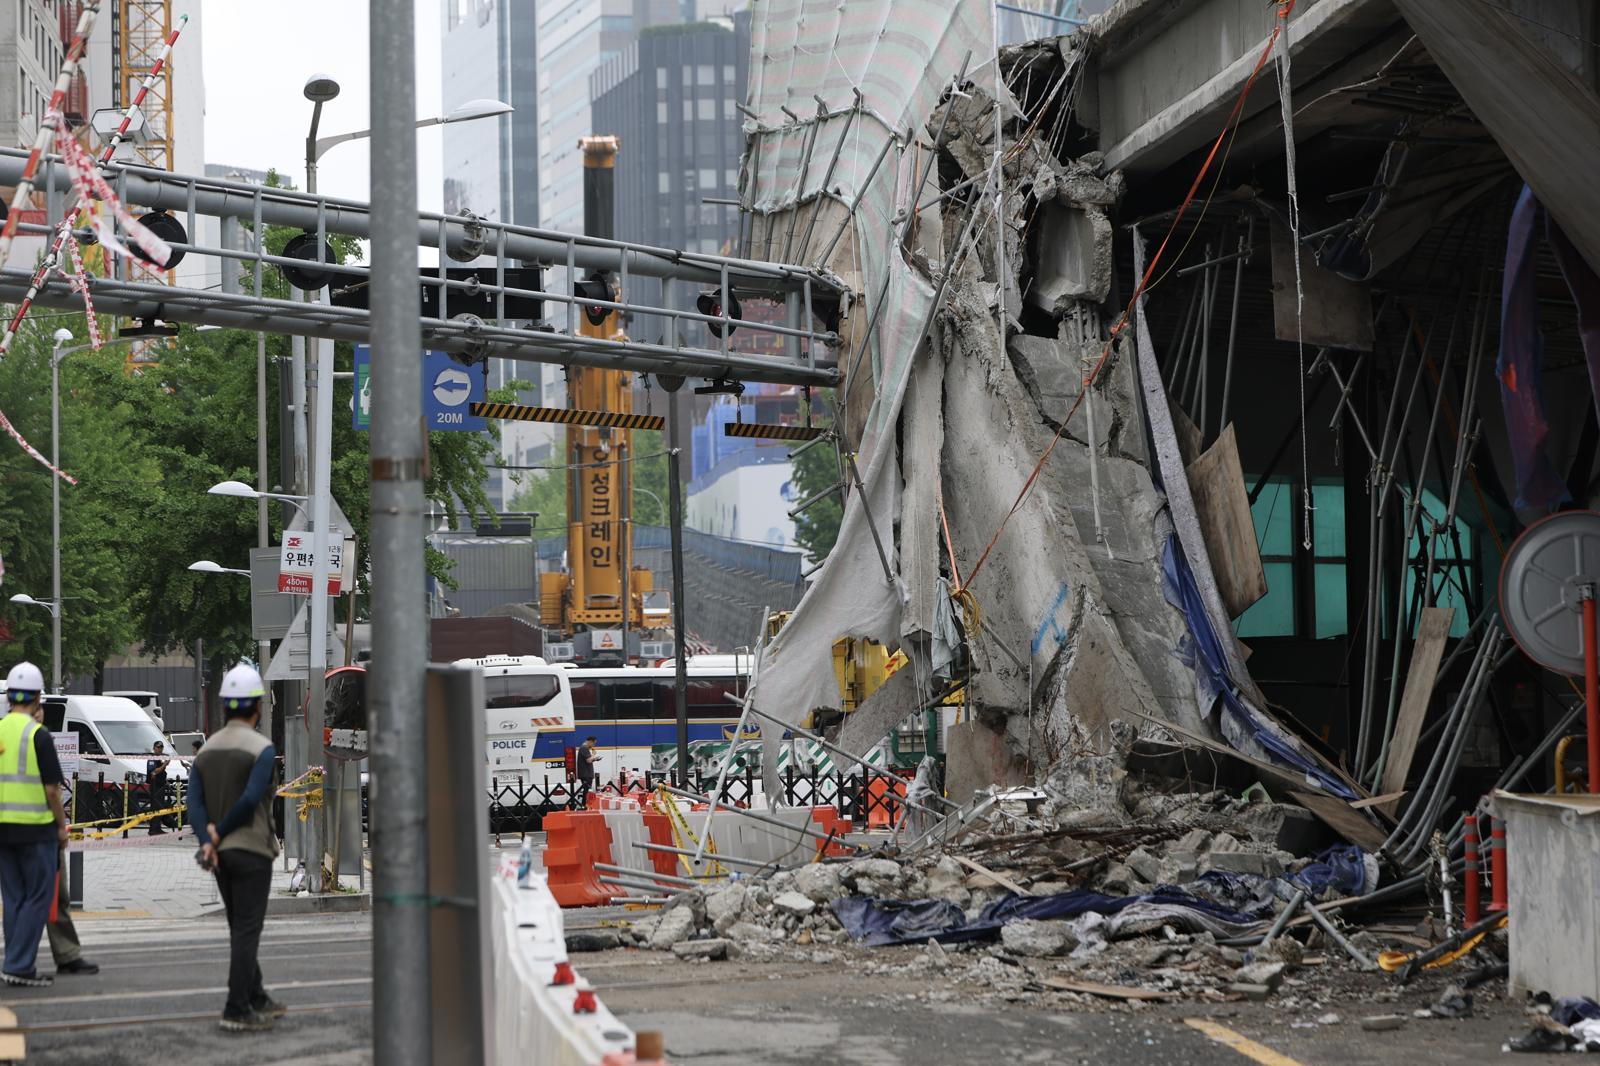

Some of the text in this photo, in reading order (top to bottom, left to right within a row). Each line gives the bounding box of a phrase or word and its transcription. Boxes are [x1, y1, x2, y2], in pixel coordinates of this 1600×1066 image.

[437, 412, 463, 424] 20M
[591, 448, 611, 568] 오성크레인
[492, 740, 527, 749] POLICE
